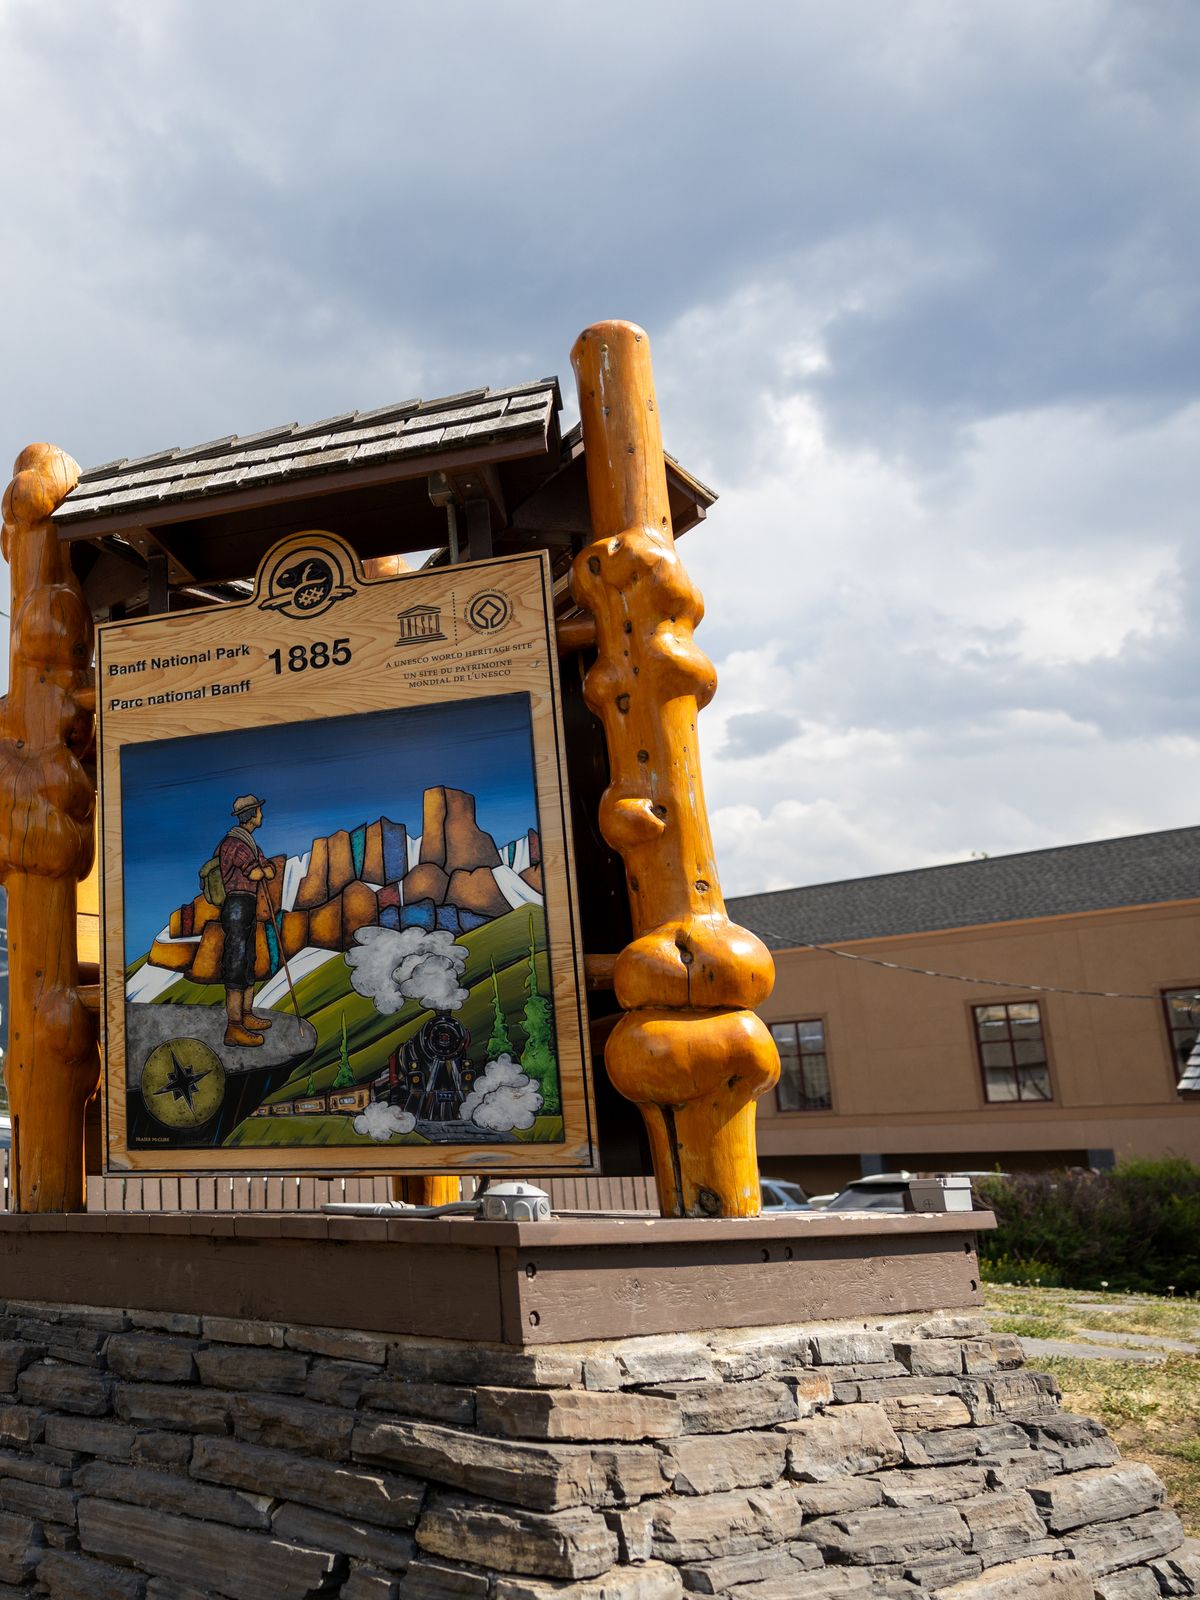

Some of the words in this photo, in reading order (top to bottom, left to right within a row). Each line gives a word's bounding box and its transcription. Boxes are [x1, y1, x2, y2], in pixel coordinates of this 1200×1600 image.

[400, 613, 440, 637] UNESCO
[109, 660, 146, 676] Banff
[151, 649, 211, 670] National
[216, 644, 250, 660] Park
[268, 638, 352, 675] 1885
[394, 656, 429, 667] UNESCO
[431, 652, 463, 662] WORLD
[465, 645, 511, 657] HERITAGE
[512, 642, 533, 651] SITE
[403, 671, 417, 680] UN
[419, 669, 438, 678] SITE
[440, 667, 453, 675] DU
[455, 659, 513, 673] PATRIMOINE
[408, 677, 449, 688] MONDIAL
[453, 673, 465, 682] DE
[467, 669, 511, 681] L'UNESCO
[111, 697, 143, 711] Parc
[148, 686, 206, 705] national
[211, 679, 250, 697] Banff
